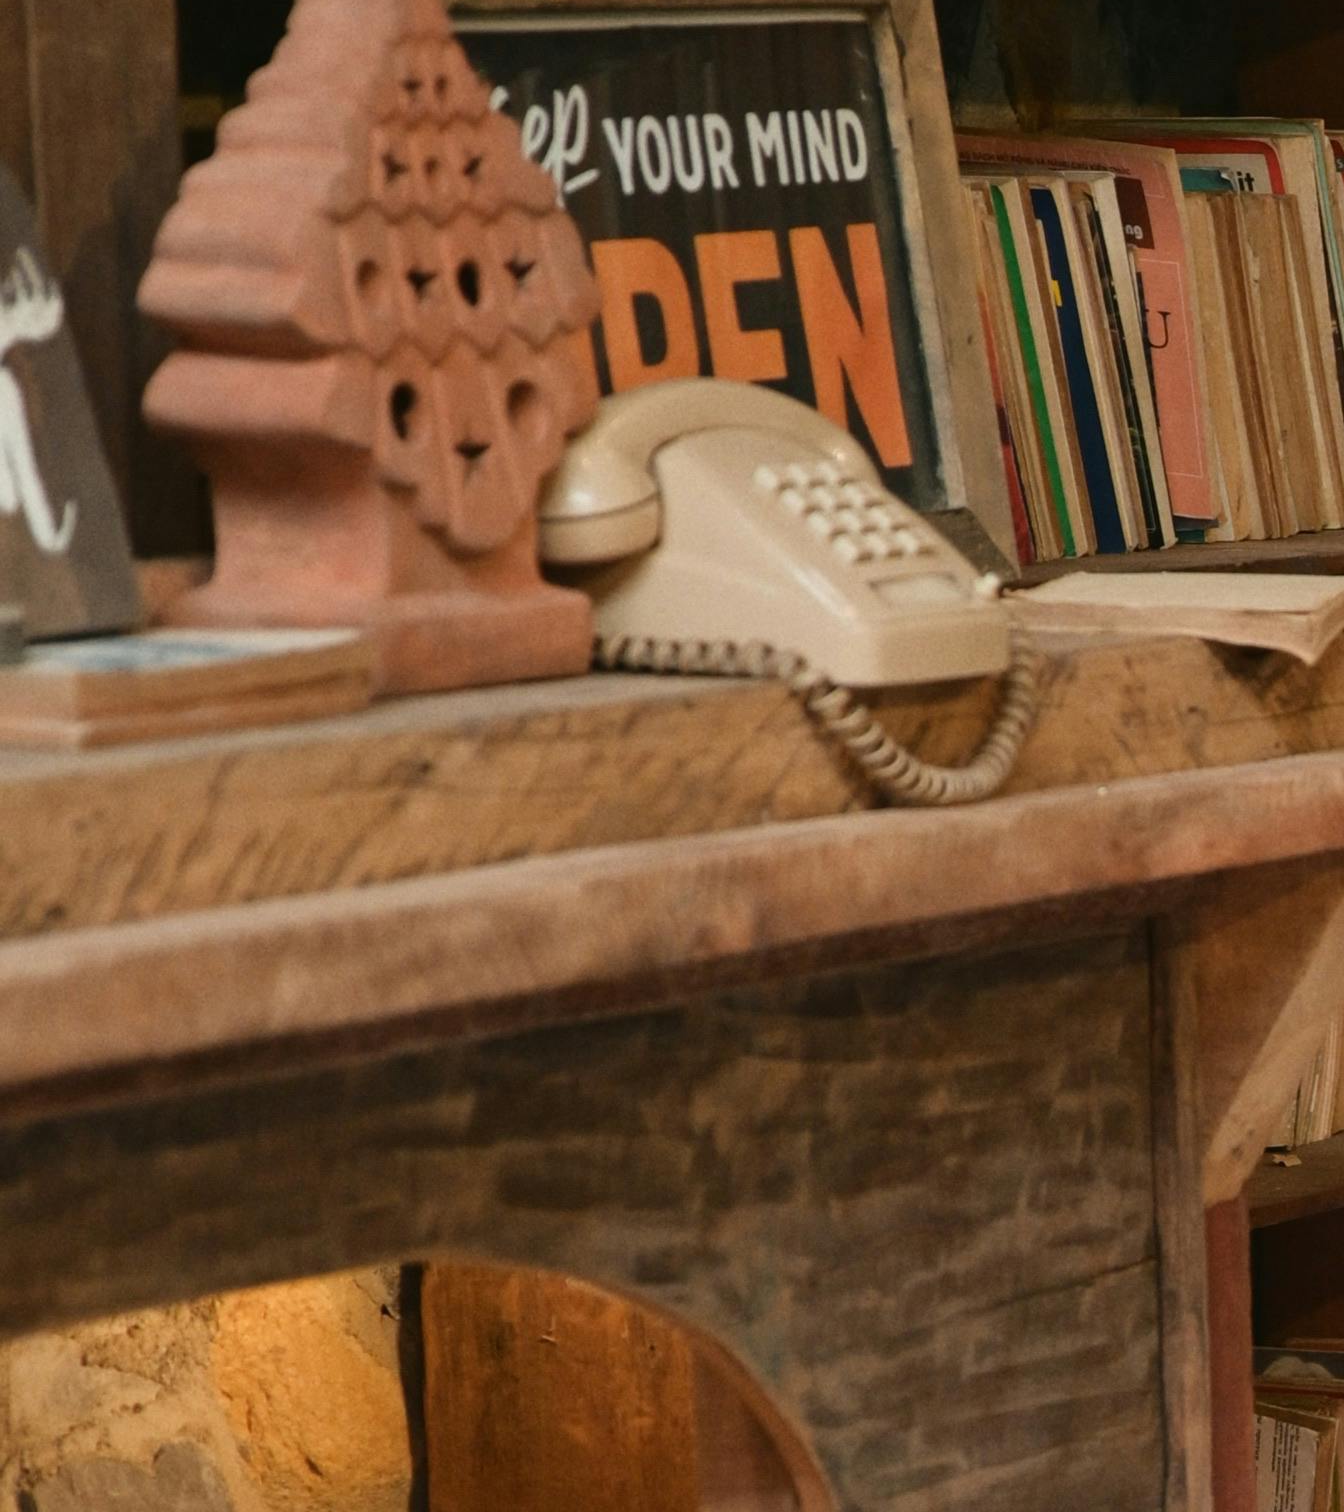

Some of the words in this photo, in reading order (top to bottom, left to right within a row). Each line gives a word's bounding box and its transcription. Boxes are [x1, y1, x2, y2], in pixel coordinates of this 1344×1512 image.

[602, 113, 740, 195] YOUR
[745, 108, 869, 187] MIND
[1236, 171, 1255, 192] it
[1125, 224, 1144, 240] ng
[567, 222, 913, 469] PEN
